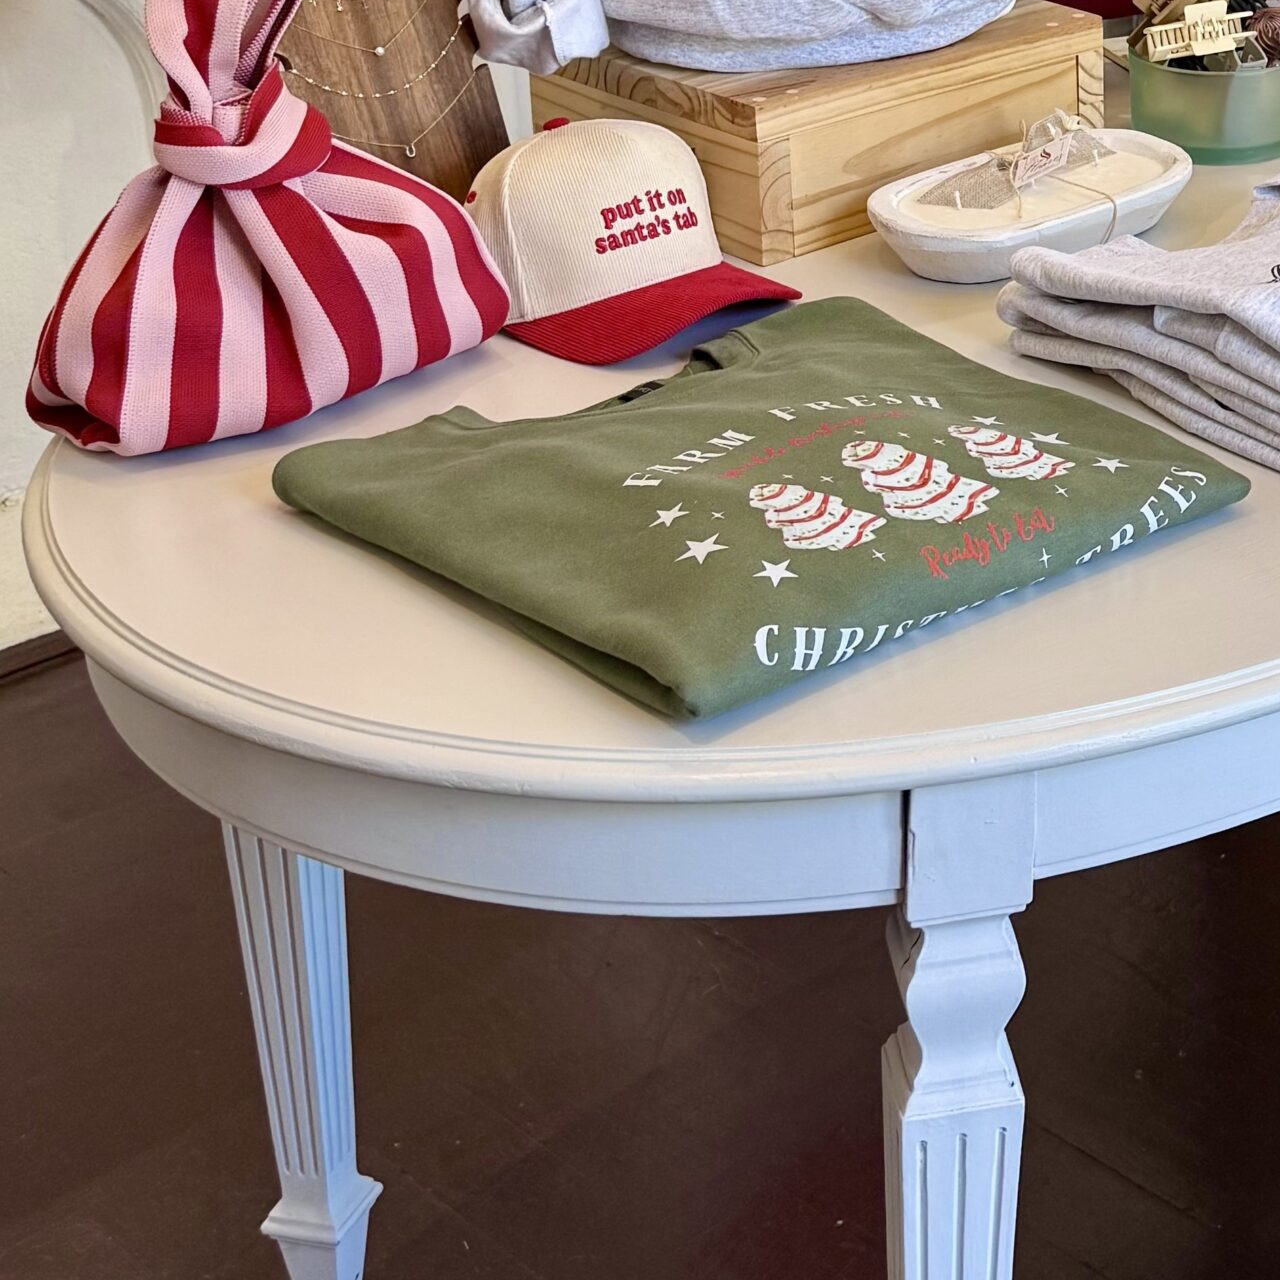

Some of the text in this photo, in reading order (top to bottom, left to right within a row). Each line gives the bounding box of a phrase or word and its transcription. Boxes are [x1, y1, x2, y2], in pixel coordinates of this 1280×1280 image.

[594, 206, 699, 254] santa's tab
[600, 187, 687, 230] put it on
[622, 428, 756, 487] FARM
[768, 393, 943, 422] FRESH
[919, 530, 991, 580] Ready
[986, 521, 1013, 553] to
